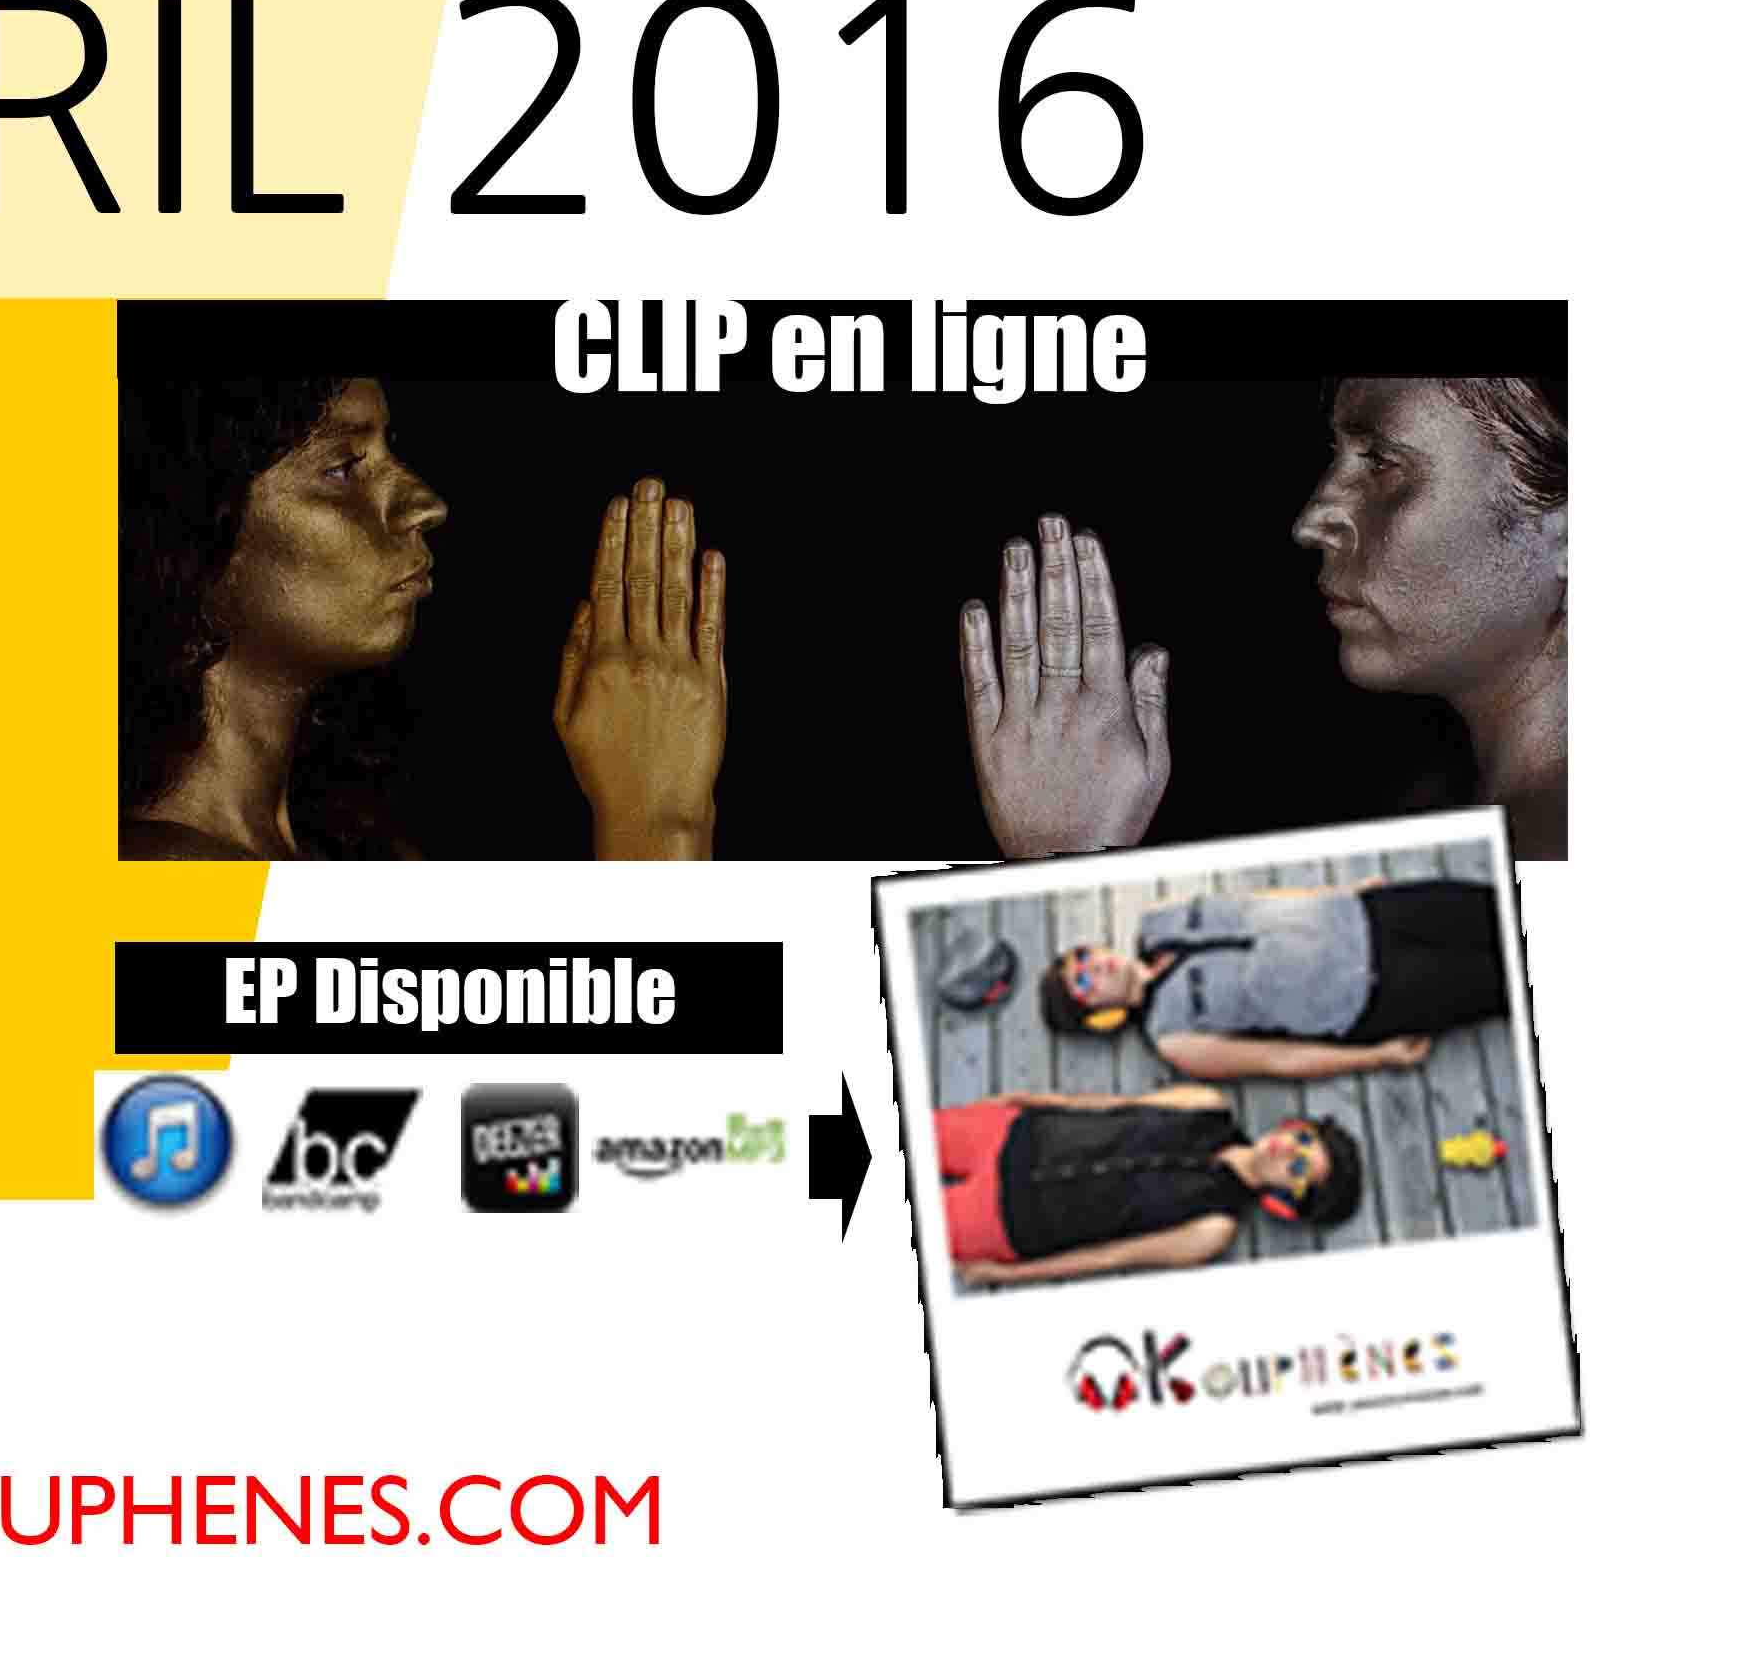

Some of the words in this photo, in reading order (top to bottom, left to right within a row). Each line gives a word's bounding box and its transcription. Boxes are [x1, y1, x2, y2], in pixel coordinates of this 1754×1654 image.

[554, 295, 748, 394] CLIP
[771, 314, 885, 393] en
[911, 295, 1147, 405] ligne
[225, 957, 298, 1024] EP
[315, 957, 676, 1032] Disponible
